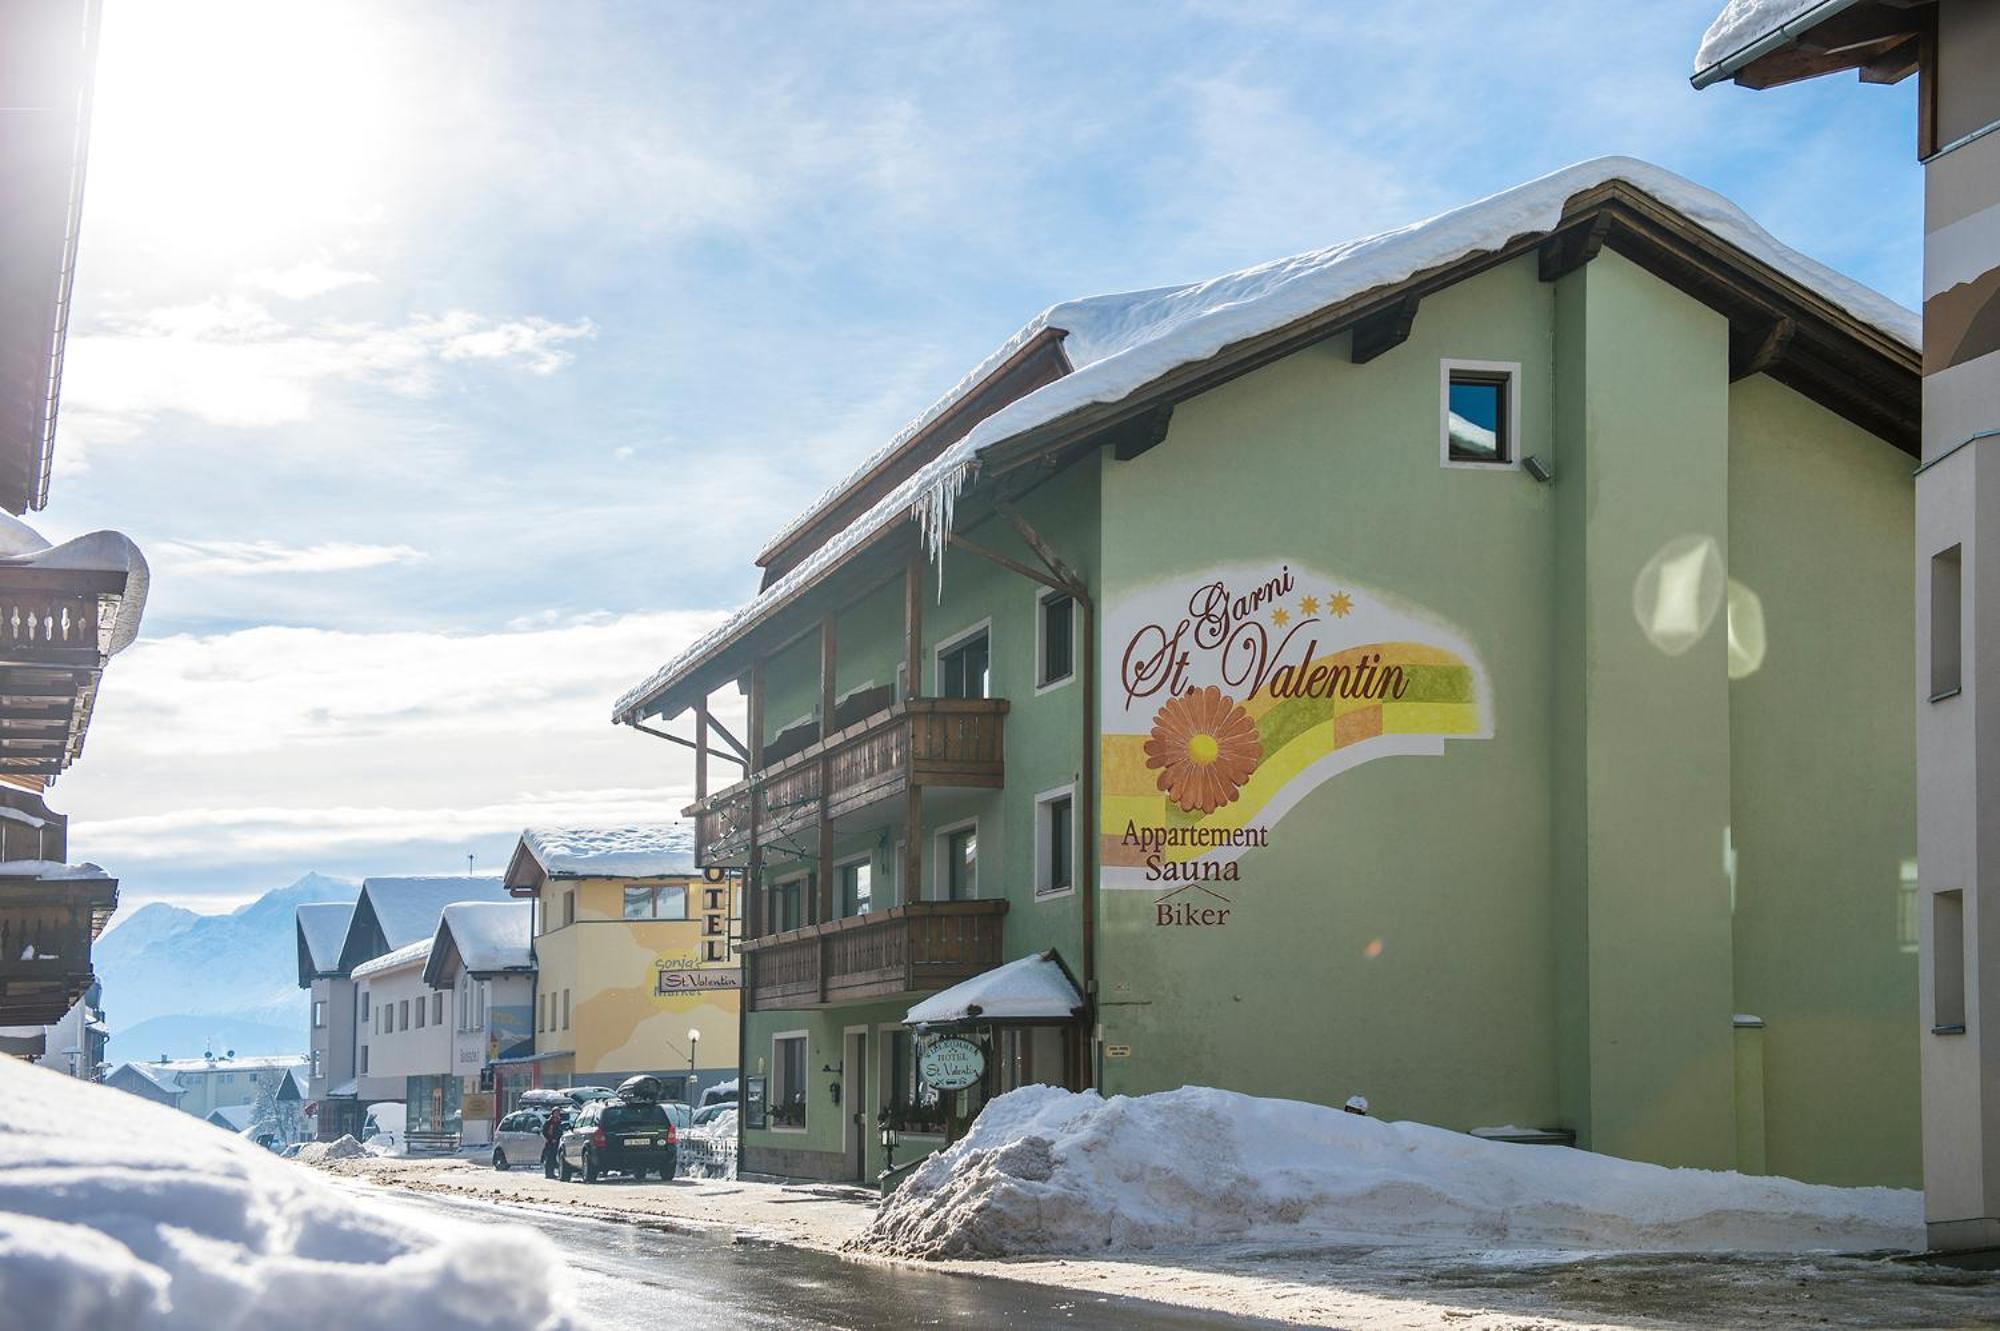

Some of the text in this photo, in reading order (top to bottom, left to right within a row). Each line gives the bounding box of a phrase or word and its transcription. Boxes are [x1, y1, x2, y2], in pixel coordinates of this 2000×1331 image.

[1189, 565, 1295, 649] Garni
[1121, 618, 1410, 711] St. Valentin
[1121, 819, 1269, 853] Appartement
[1145, 855, 1242, 882] Sauna
[1156, 903, 1231, 927] Biker
[688, 973, 737, 988] Valentin
[937, 1052, 968, 1062] HOTEL
